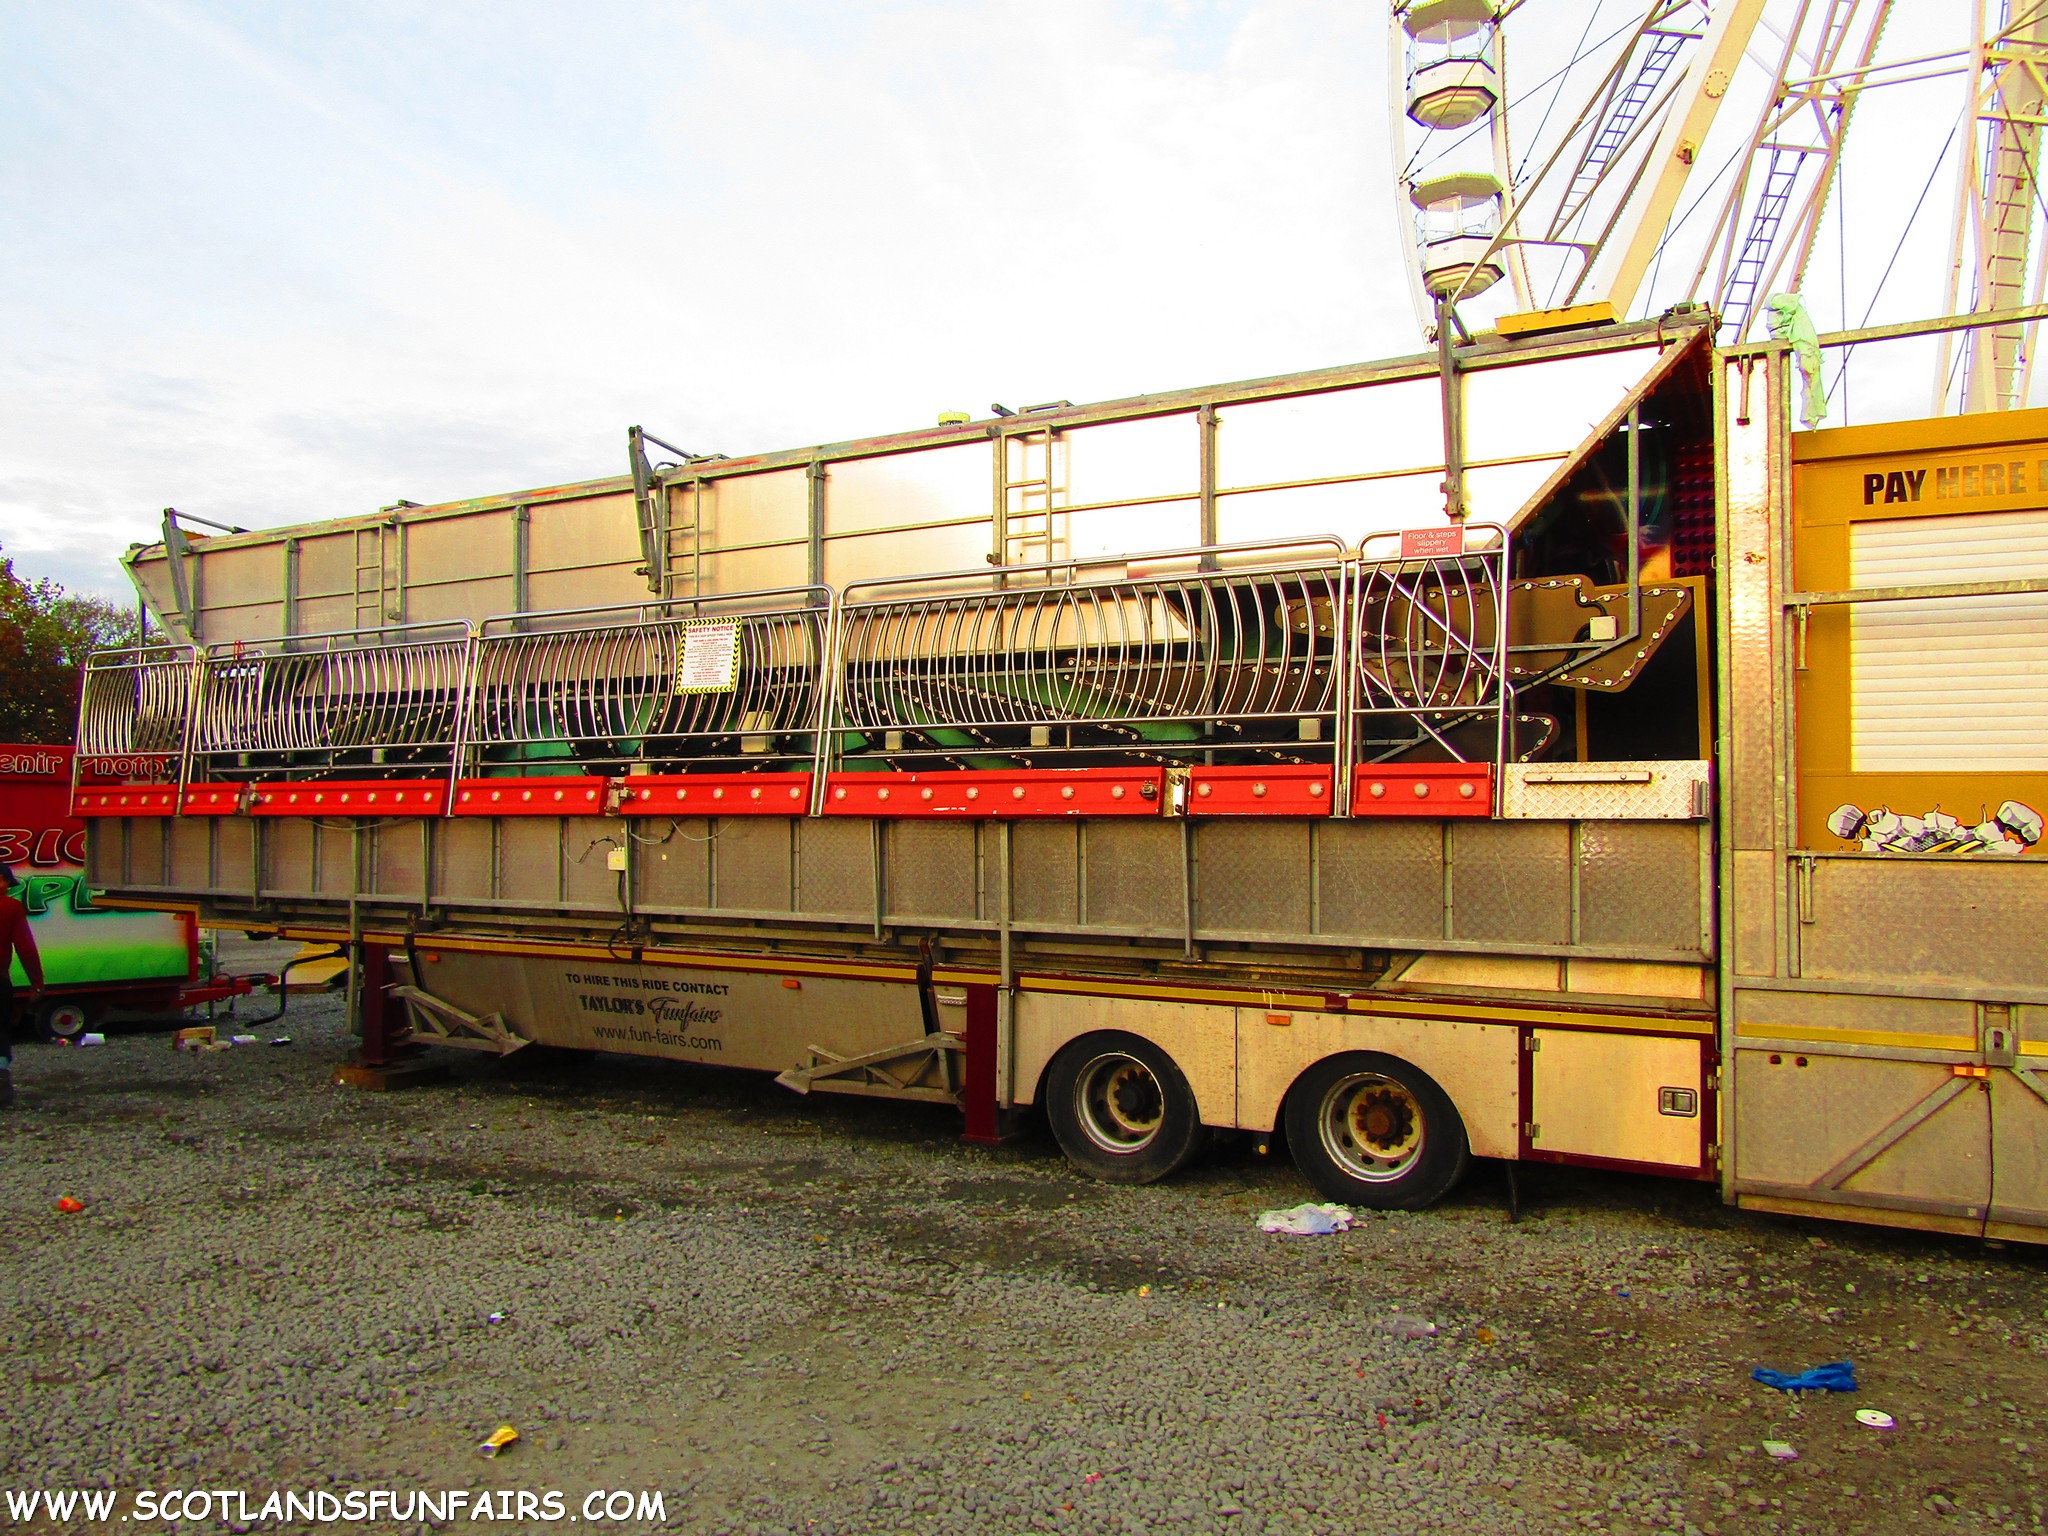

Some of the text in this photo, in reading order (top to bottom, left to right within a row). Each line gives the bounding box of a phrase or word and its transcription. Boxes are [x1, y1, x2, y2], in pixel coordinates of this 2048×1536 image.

[1864, 469, 1926, 505] PAY
[1936, 461, 2026, 499] HERE
[566, 973, 729, 996] TO HIRE THIS RIDE CONTACT
[579, 995, 723, 1032] TAYLOR'S Funfairs
[592, 1026, 722, 1051] www.fun-fairs.com
